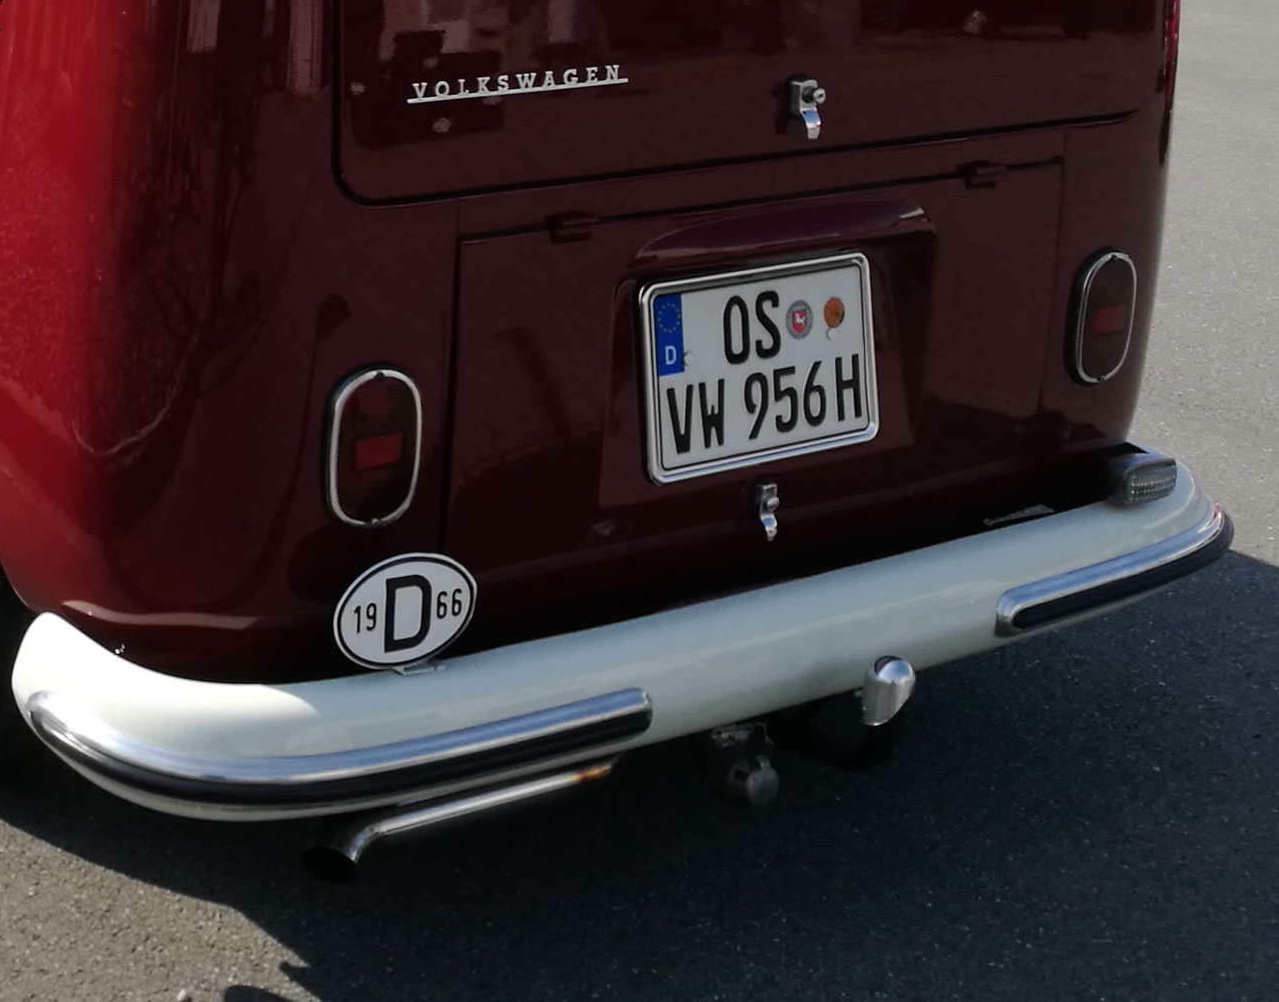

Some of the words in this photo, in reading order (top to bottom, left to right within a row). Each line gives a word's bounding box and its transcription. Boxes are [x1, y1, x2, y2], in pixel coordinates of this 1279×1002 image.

[412, 64, 620, 98] VOLKSWAGEN
[665, 345, 677, 365] D
[722, 290, 781, 365] OS
[666, 378, 725, 454] VW
[353, 602, 378, 634] 19
[383, 574, 433, 653] D
[436, 588, 463, 620] 66
